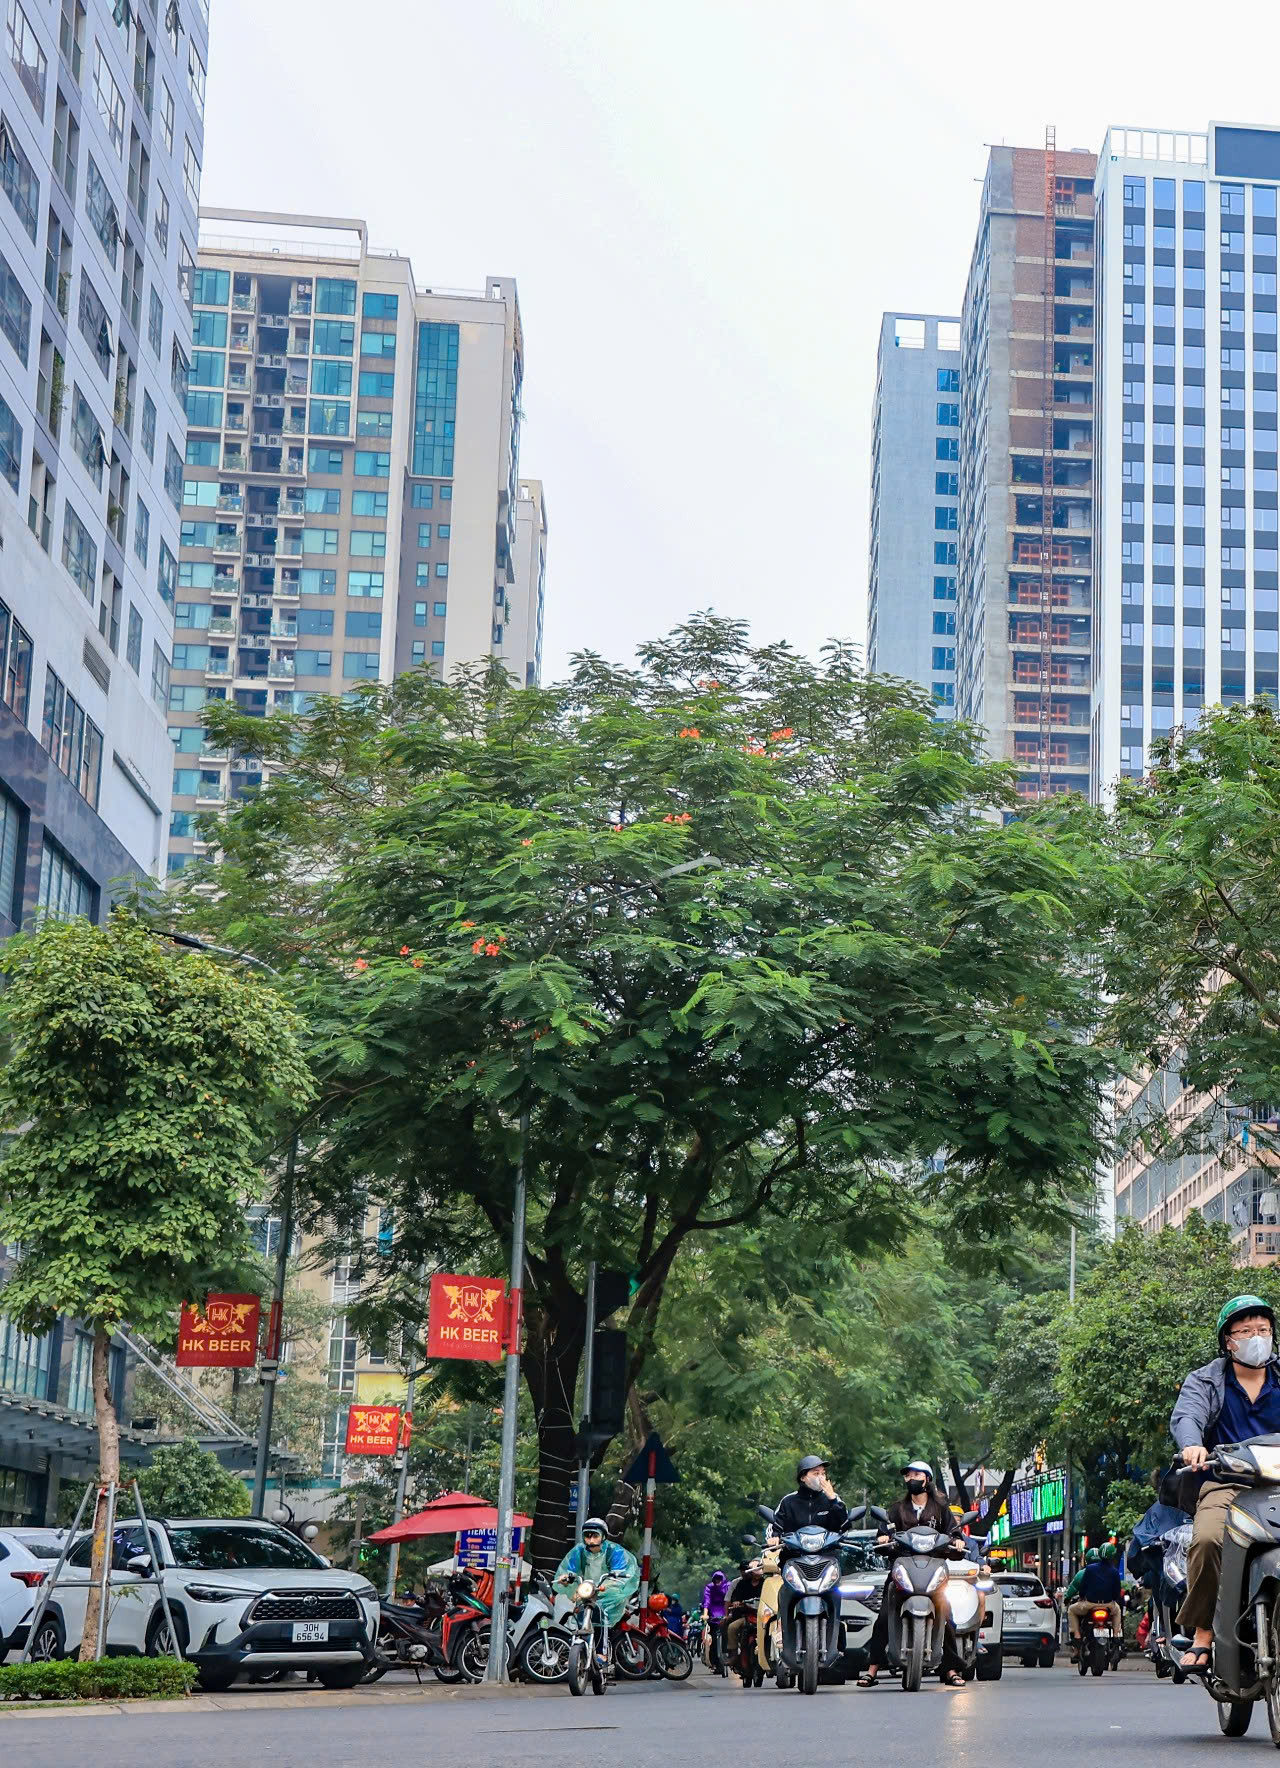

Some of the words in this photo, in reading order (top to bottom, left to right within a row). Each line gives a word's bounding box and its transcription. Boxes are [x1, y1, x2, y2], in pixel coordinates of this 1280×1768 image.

[440, 1325, 460, 1340] HK
[463, 1327, 499, 1343] BEER
[182, 1339, 205, 1352] HK
[208, 1339, 251, 1352] BEER
[350, 1435, 365, 1444] HK
[366, 1436, 393, 1445] BEER
[304, 1624, 319, 1632] 30H
[296, 1633, 325, 1641] 656.94
